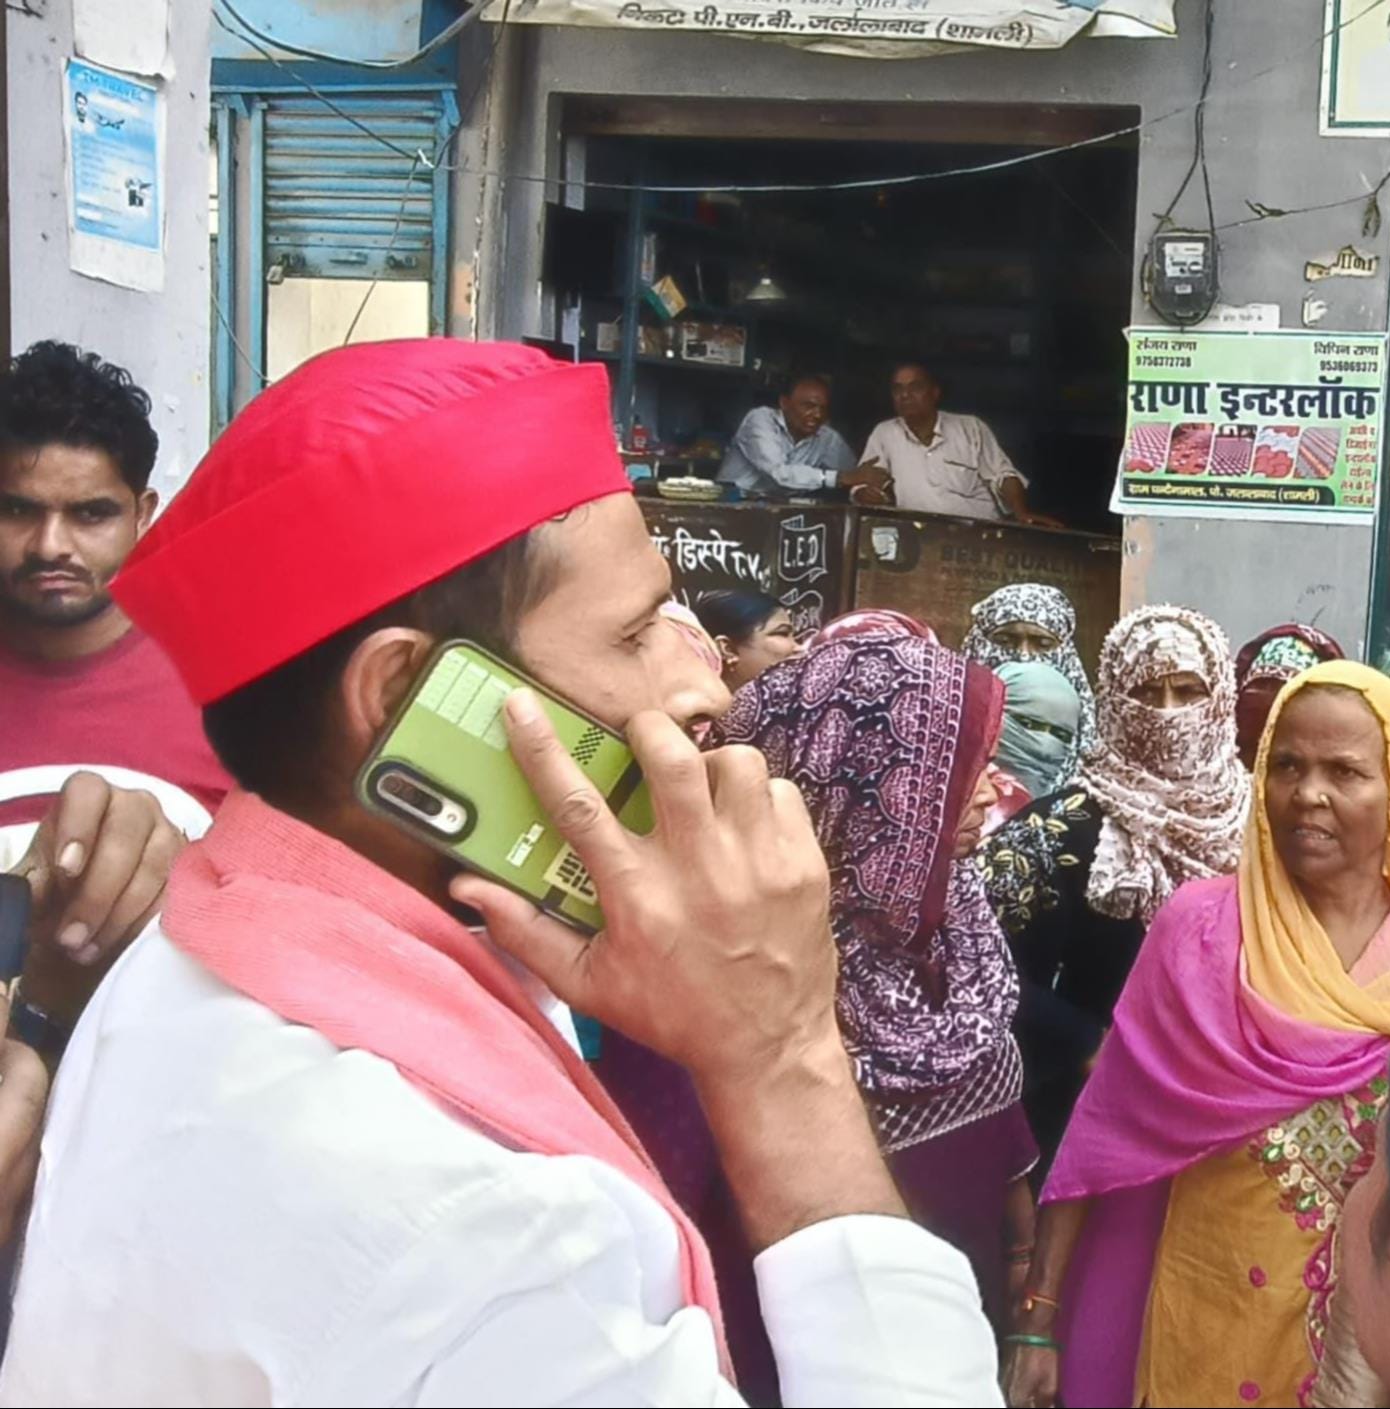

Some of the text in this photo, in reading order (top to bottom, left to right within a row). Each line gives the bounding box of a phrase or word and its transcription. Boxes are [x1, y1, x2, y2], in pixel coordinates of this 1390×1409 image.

[1171, 341, 1197, 351] राणा
[1314, 341, 1379, 356] विपिन राणा
[1129, 375, 1380, 420] राणा इन्टरलॉक
